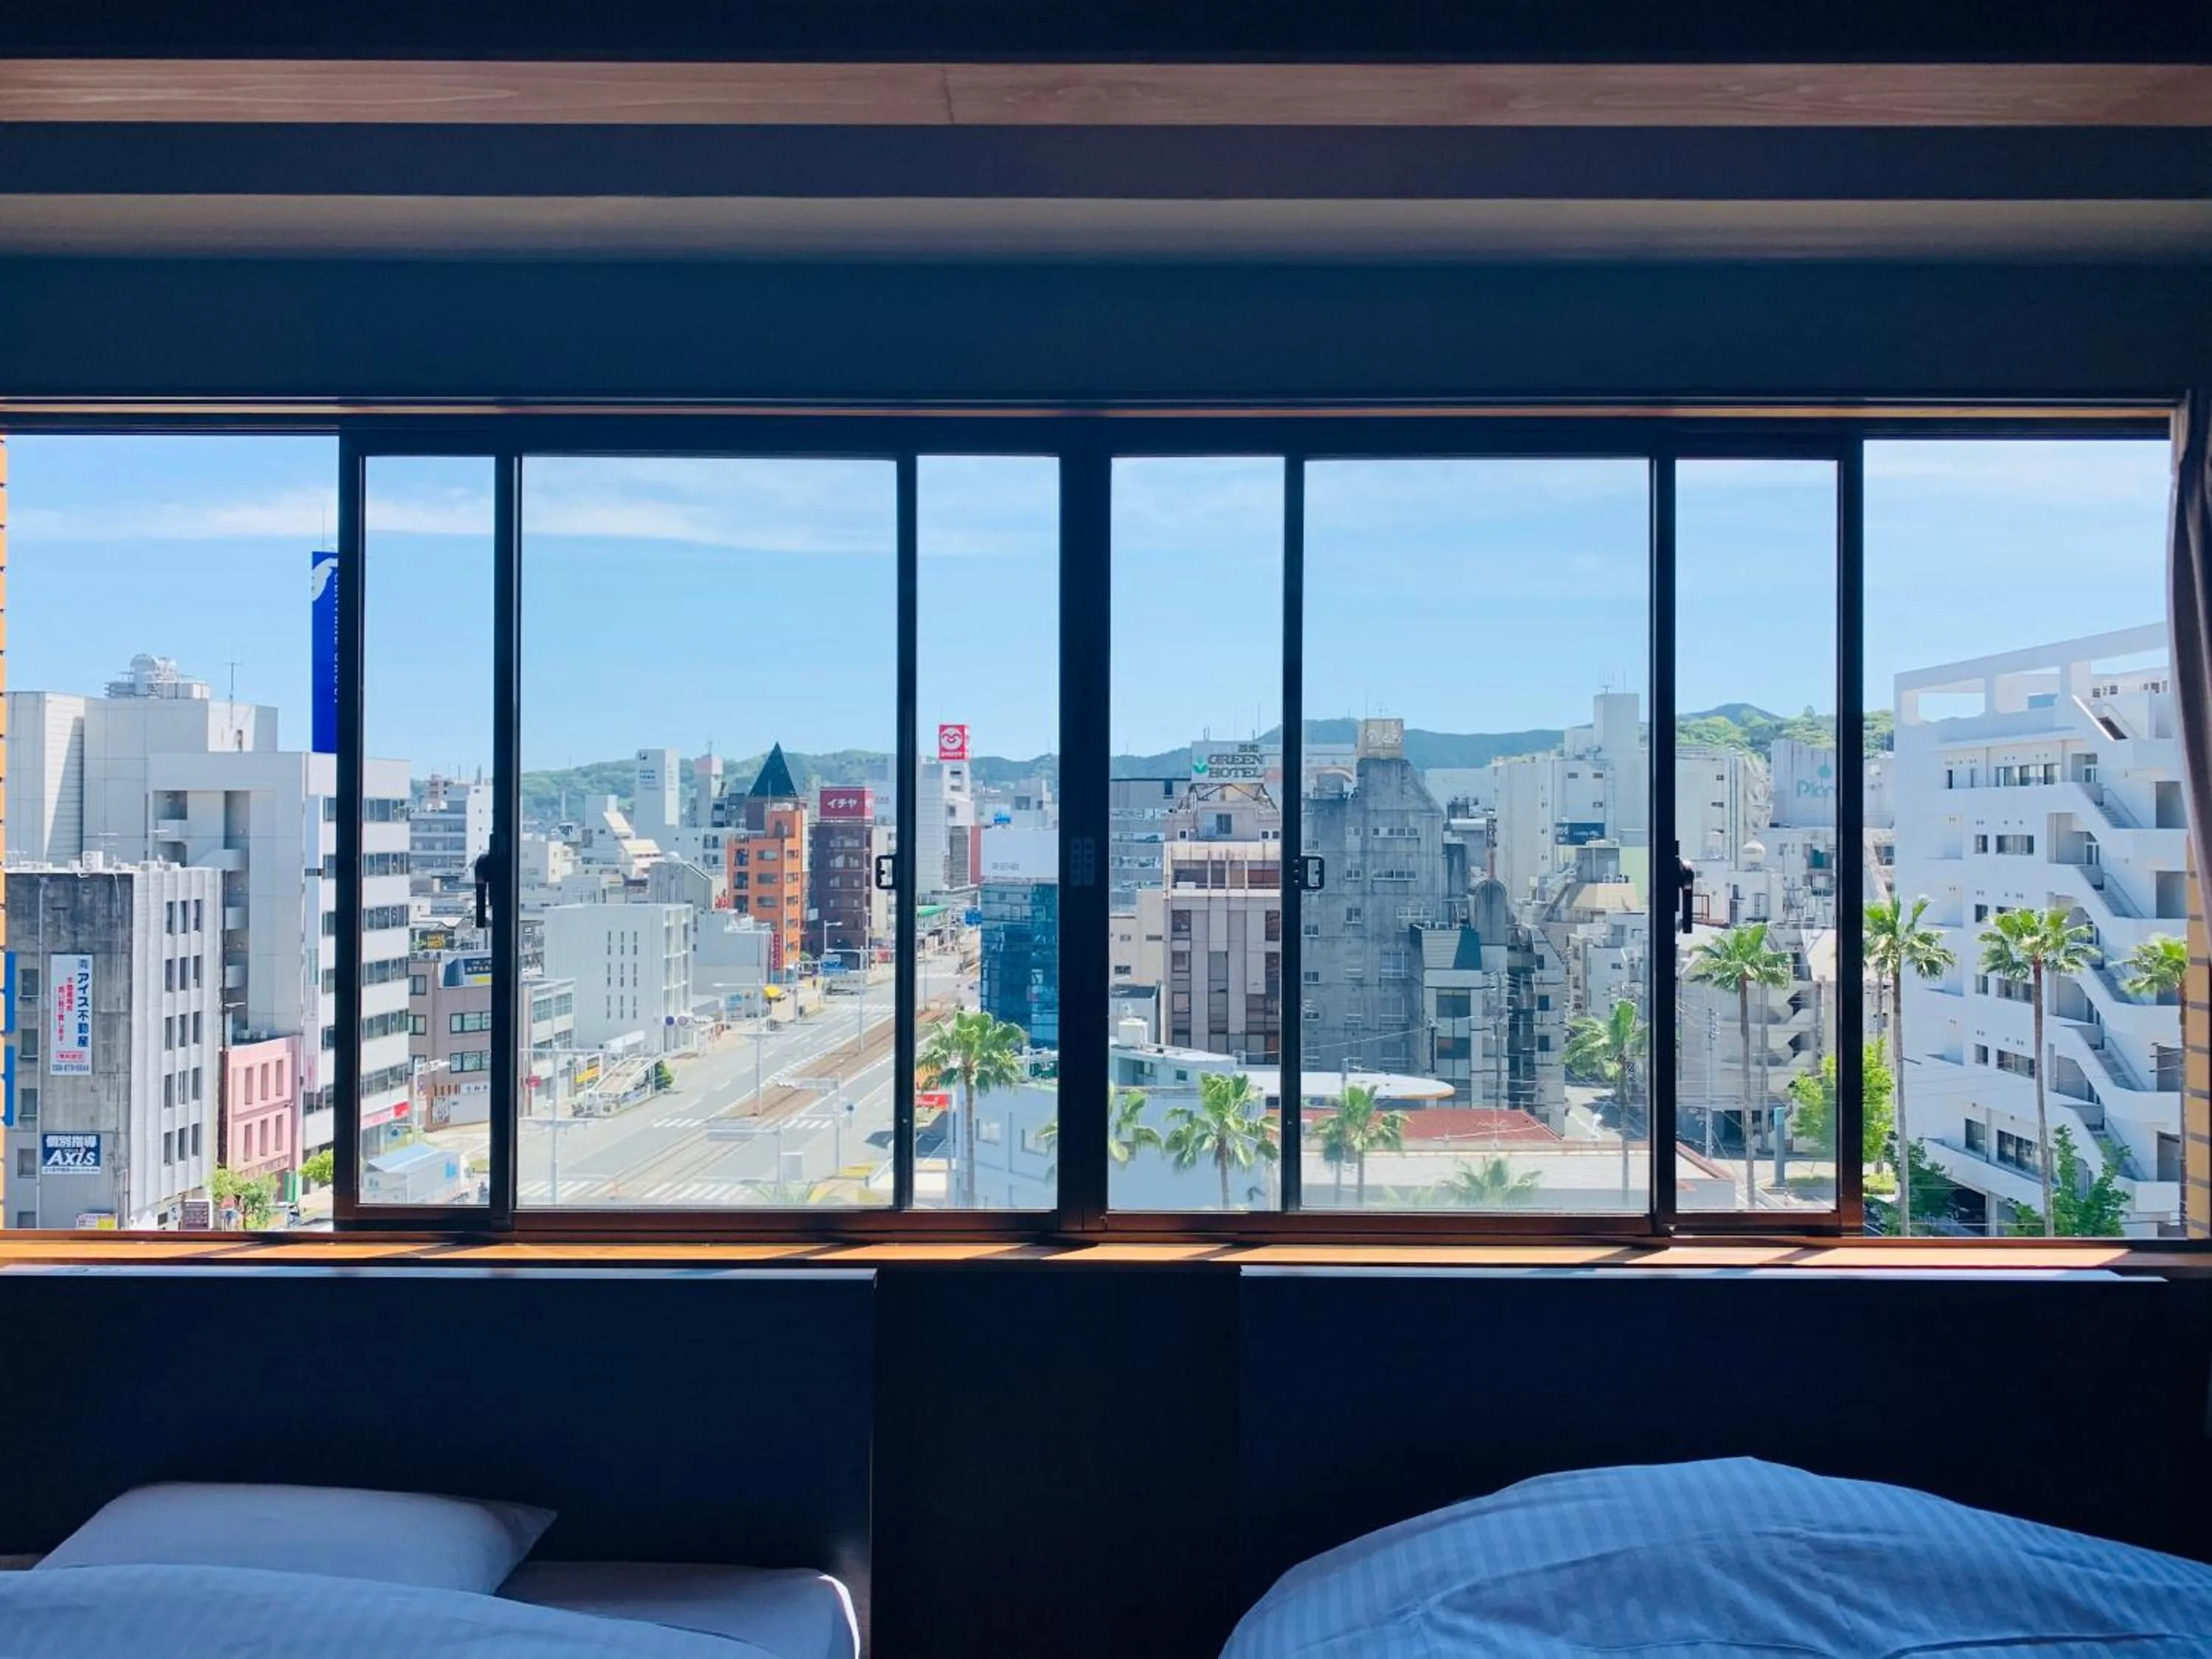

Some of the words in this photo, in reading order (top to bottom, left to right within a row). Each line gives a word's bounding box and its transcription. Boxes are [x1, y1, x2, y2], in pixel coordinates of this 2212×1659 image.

[1208, 754, 1263, 765] GREEN
[1208, 768, 1265, 779] HOTEL
[827, 798, 858, 810] イチヤ
[46, 1147, 96, 1166] Axis
